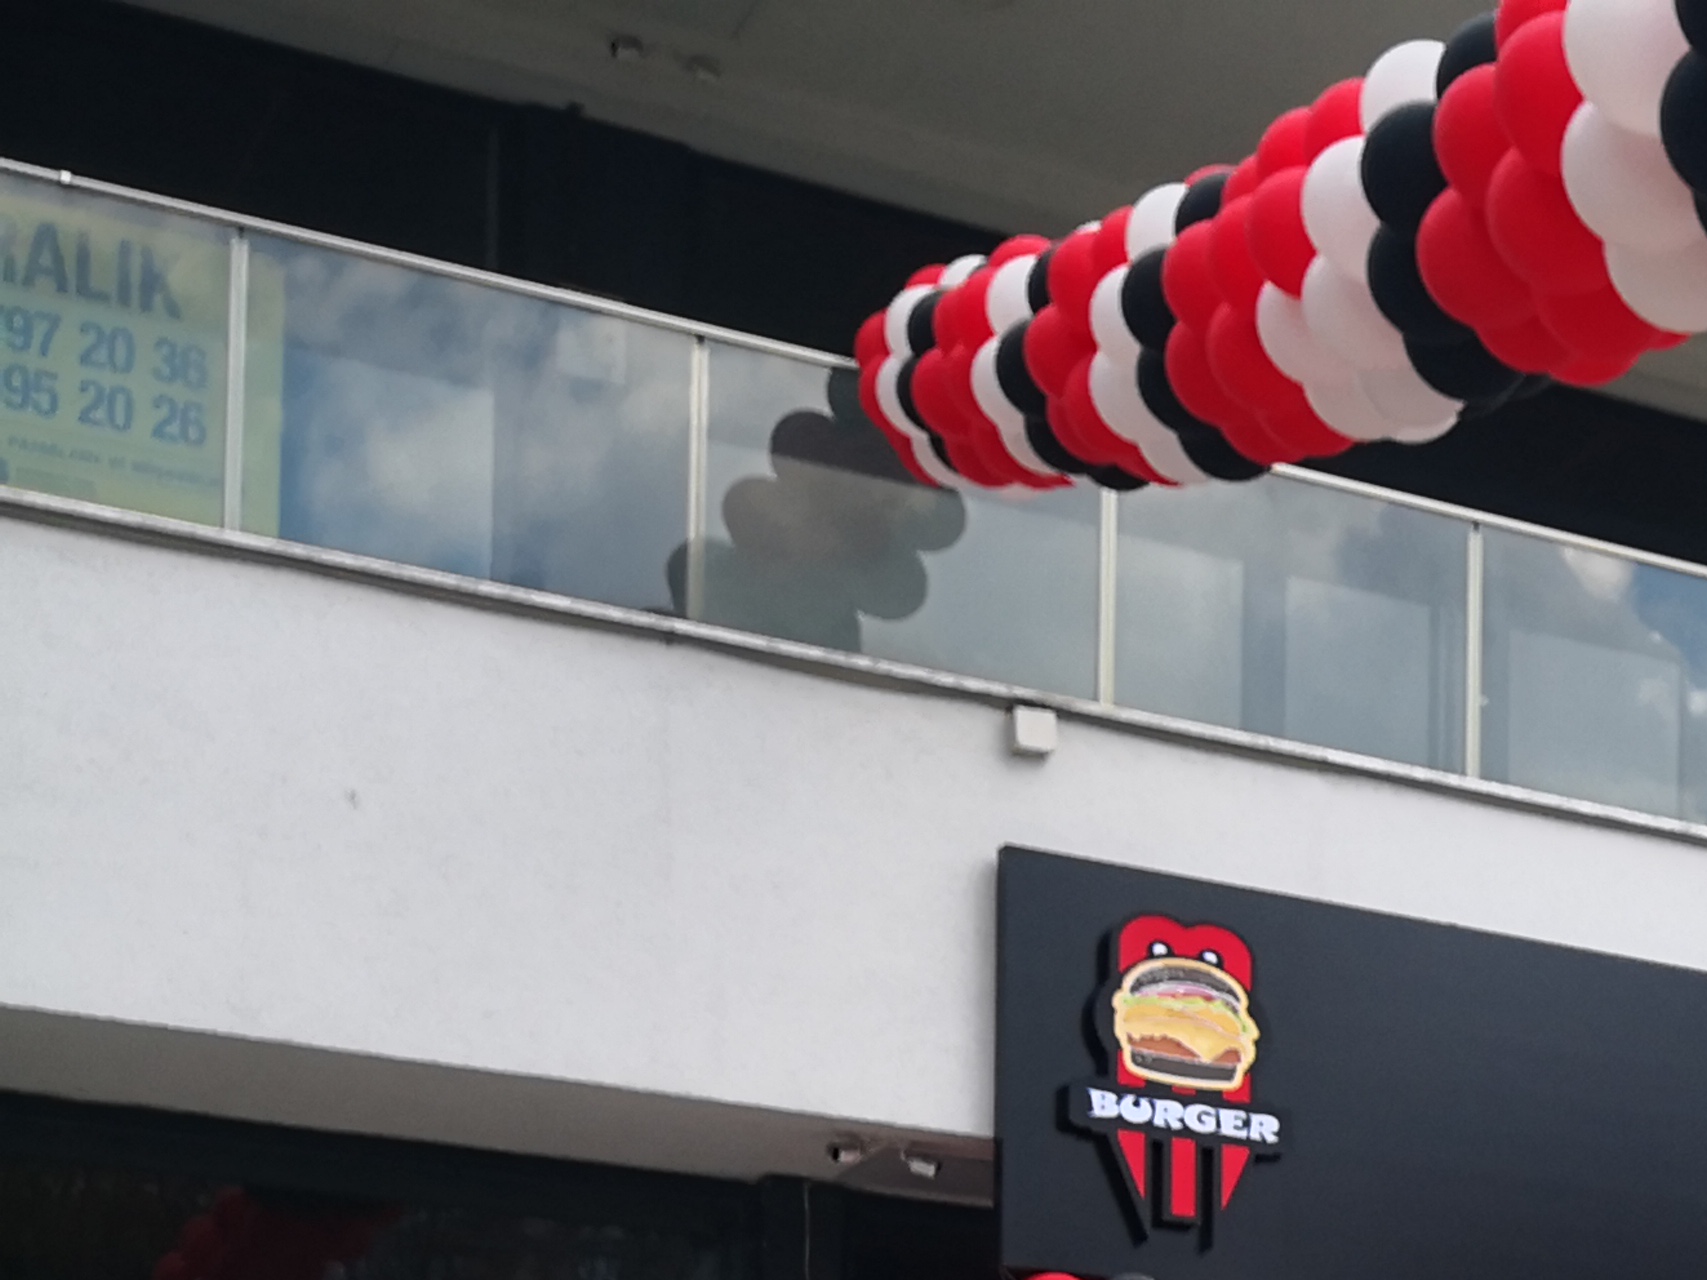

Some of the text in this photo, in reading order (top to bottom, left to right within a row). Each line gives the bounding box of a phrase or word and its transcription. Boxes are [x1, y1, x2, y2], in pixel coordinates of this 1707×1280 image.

[79, 319, 136, 374] 20
[78, 378, 134, 432] 20
[1085, 1084, 1280, 1145] BURGER
